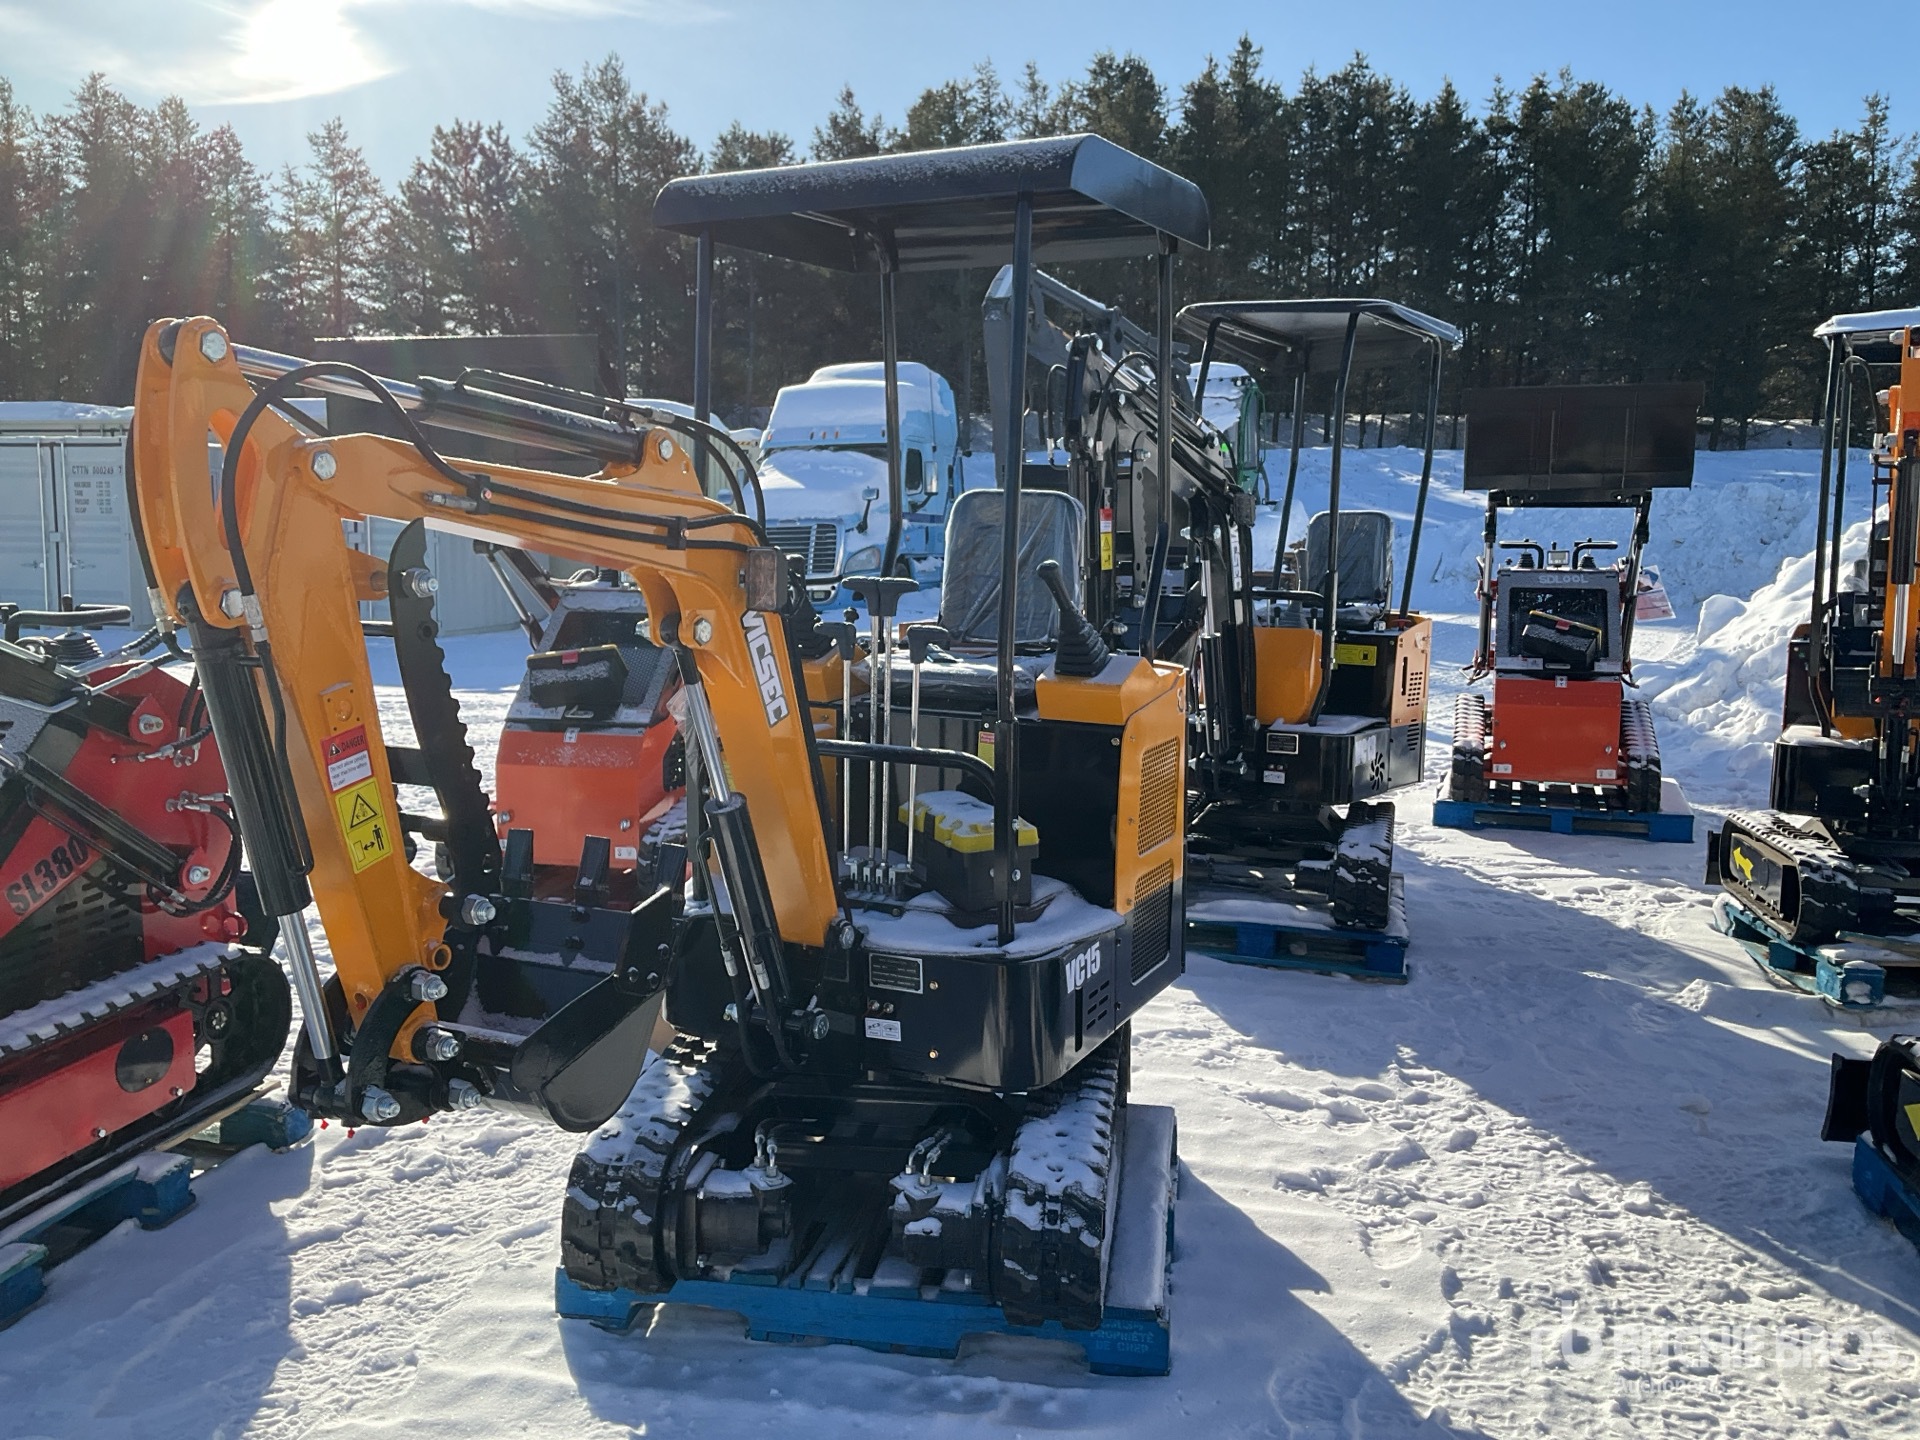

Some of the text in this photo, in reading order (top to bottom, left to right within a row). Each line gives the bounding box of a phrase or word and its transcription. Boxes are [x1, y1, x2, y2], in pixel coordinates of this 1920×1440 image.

[741, 608, 790, 728] VICSEC
[341, 735, 365, 751] DANGER
[6, 834, 89, 916] SL380
[1065, 941, 1101, 994] VC15
